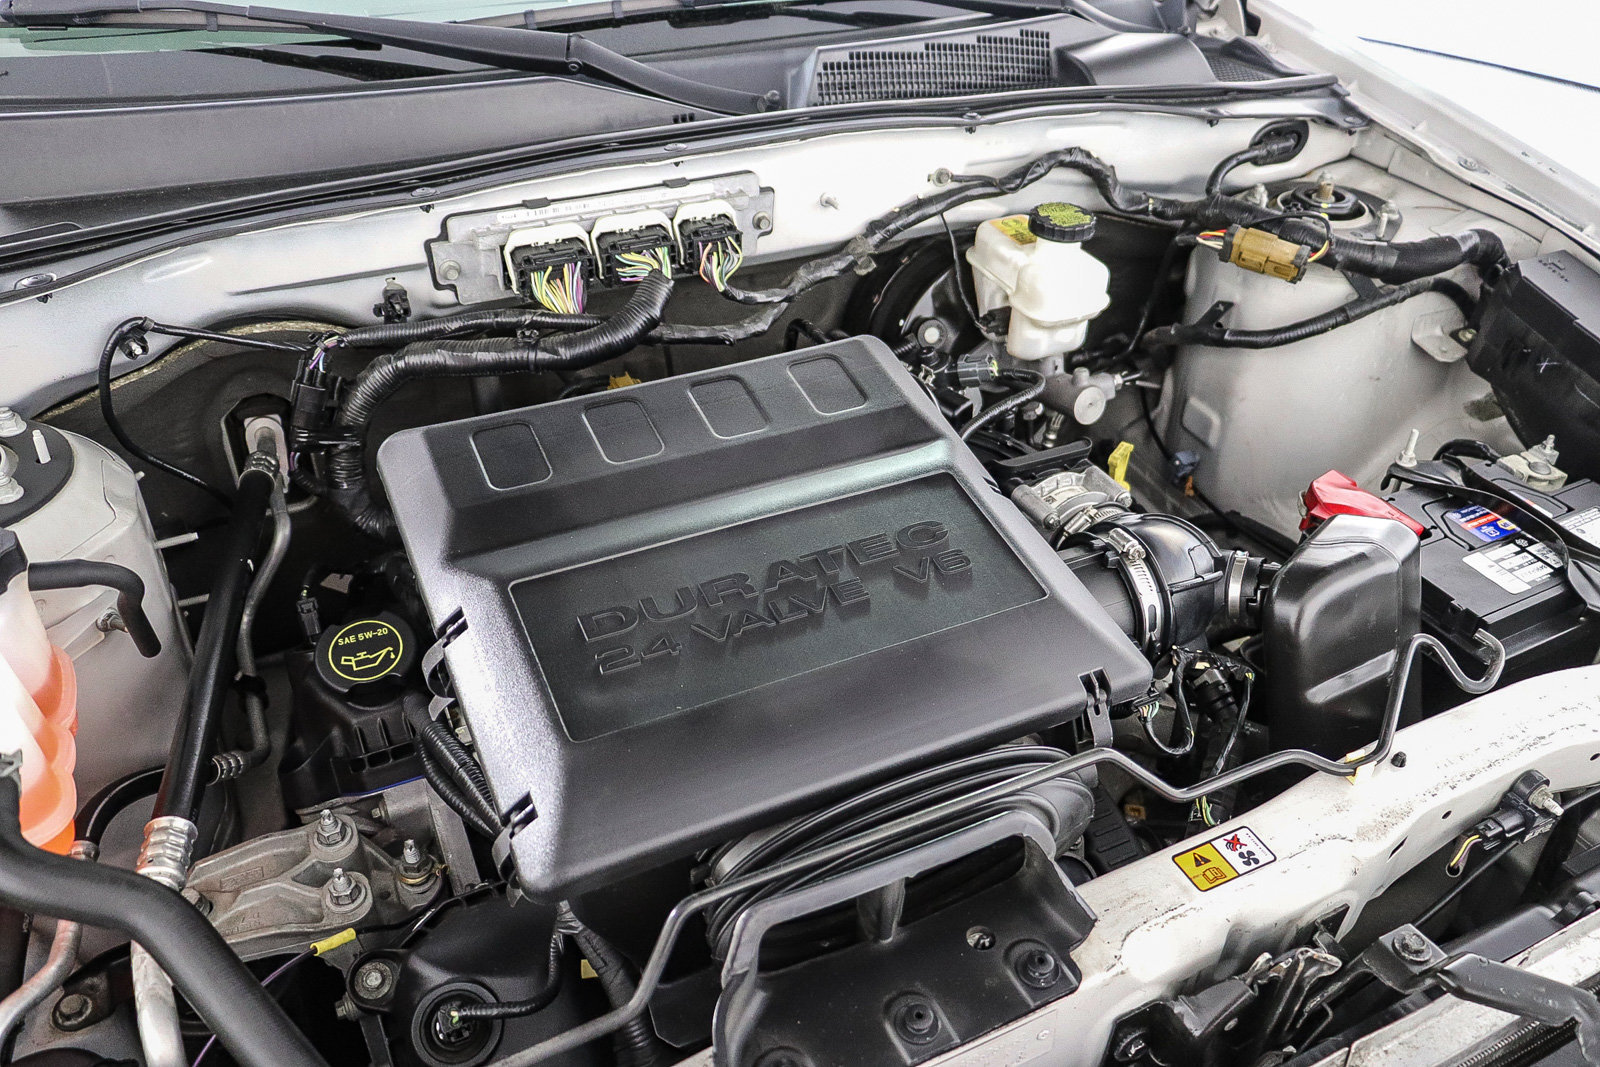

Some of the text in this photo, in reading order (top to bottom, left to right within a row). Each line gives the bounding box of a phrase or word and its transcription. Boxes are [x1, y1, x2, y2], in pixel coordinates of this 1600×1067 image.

[337, 627, 388, 645] SAE 5W-20
[576, 520, 951, 643] DURATEC
[595, 548, 973, 677] 24 VALVE V6
